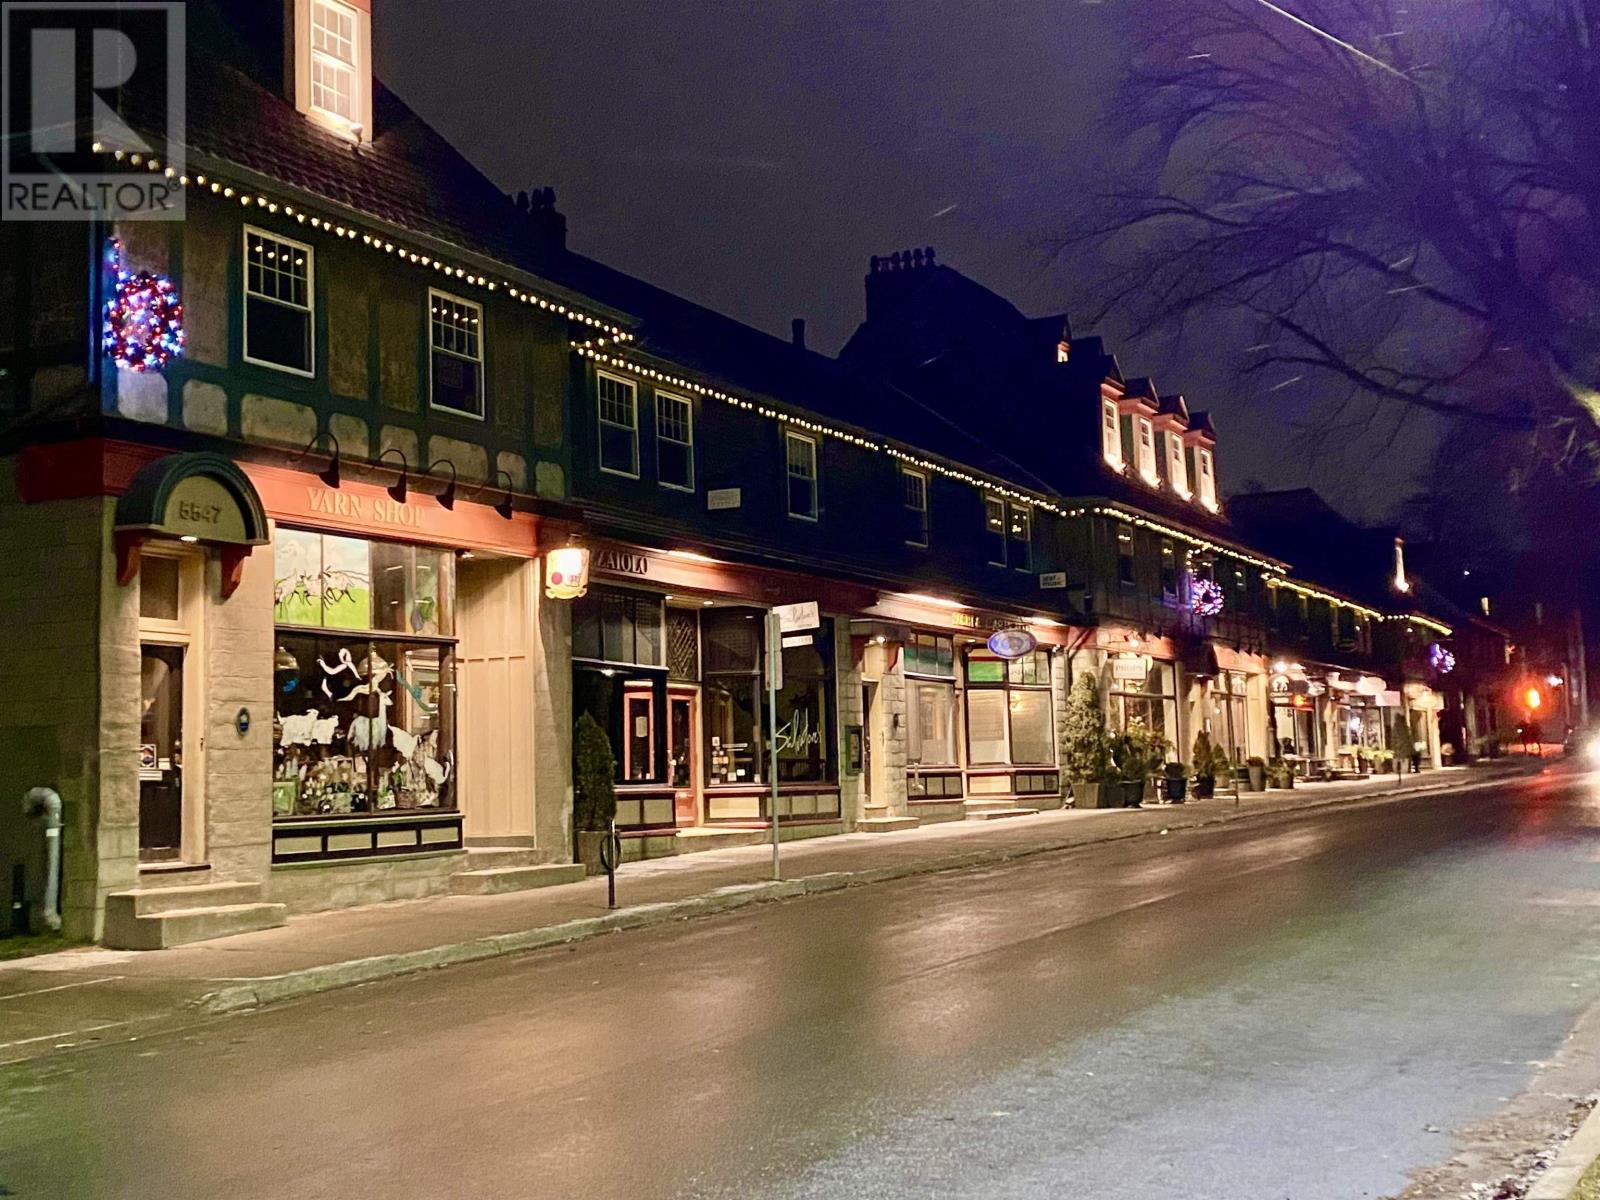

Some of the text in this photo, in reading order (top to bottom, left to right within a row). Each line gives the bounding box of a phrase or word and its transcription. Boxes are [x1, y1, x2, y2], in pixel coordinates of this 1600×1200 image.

[180, 500, 221, 524] 5547
[306, 487, 425, 528] YARN SHOP
[596, 550, 649, 575] ZAIOLO
